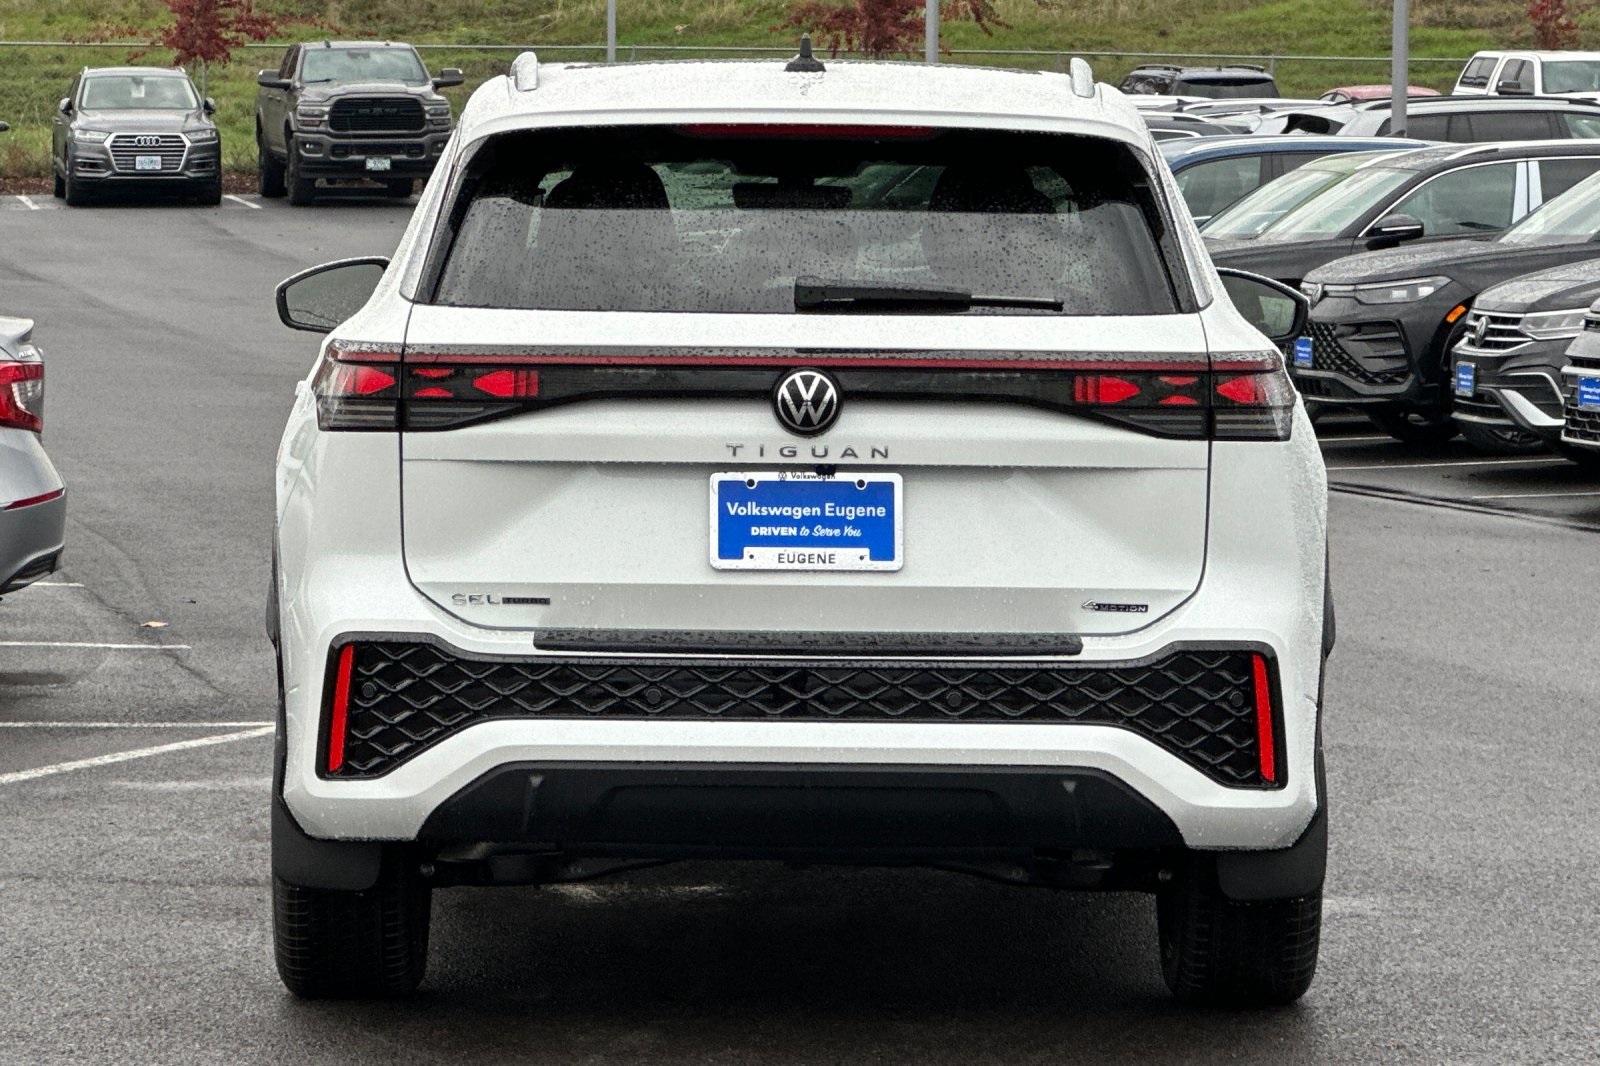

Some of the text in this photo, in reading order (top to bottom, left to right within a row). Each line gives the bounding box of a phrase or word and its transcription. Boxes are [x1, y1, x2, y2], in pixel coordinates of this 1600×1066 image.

[725, 444, 889, 459] TIGUAN
[726, 501, 887, 520] Volkswagen Eugene
[751, 525, 862, 537] DRIVEN to Serve You
[777, 553, 837, 564] EUGENE
[451, 593, 501, 605] SEL
[1081, 599, 1148, 613] 4MOTION
